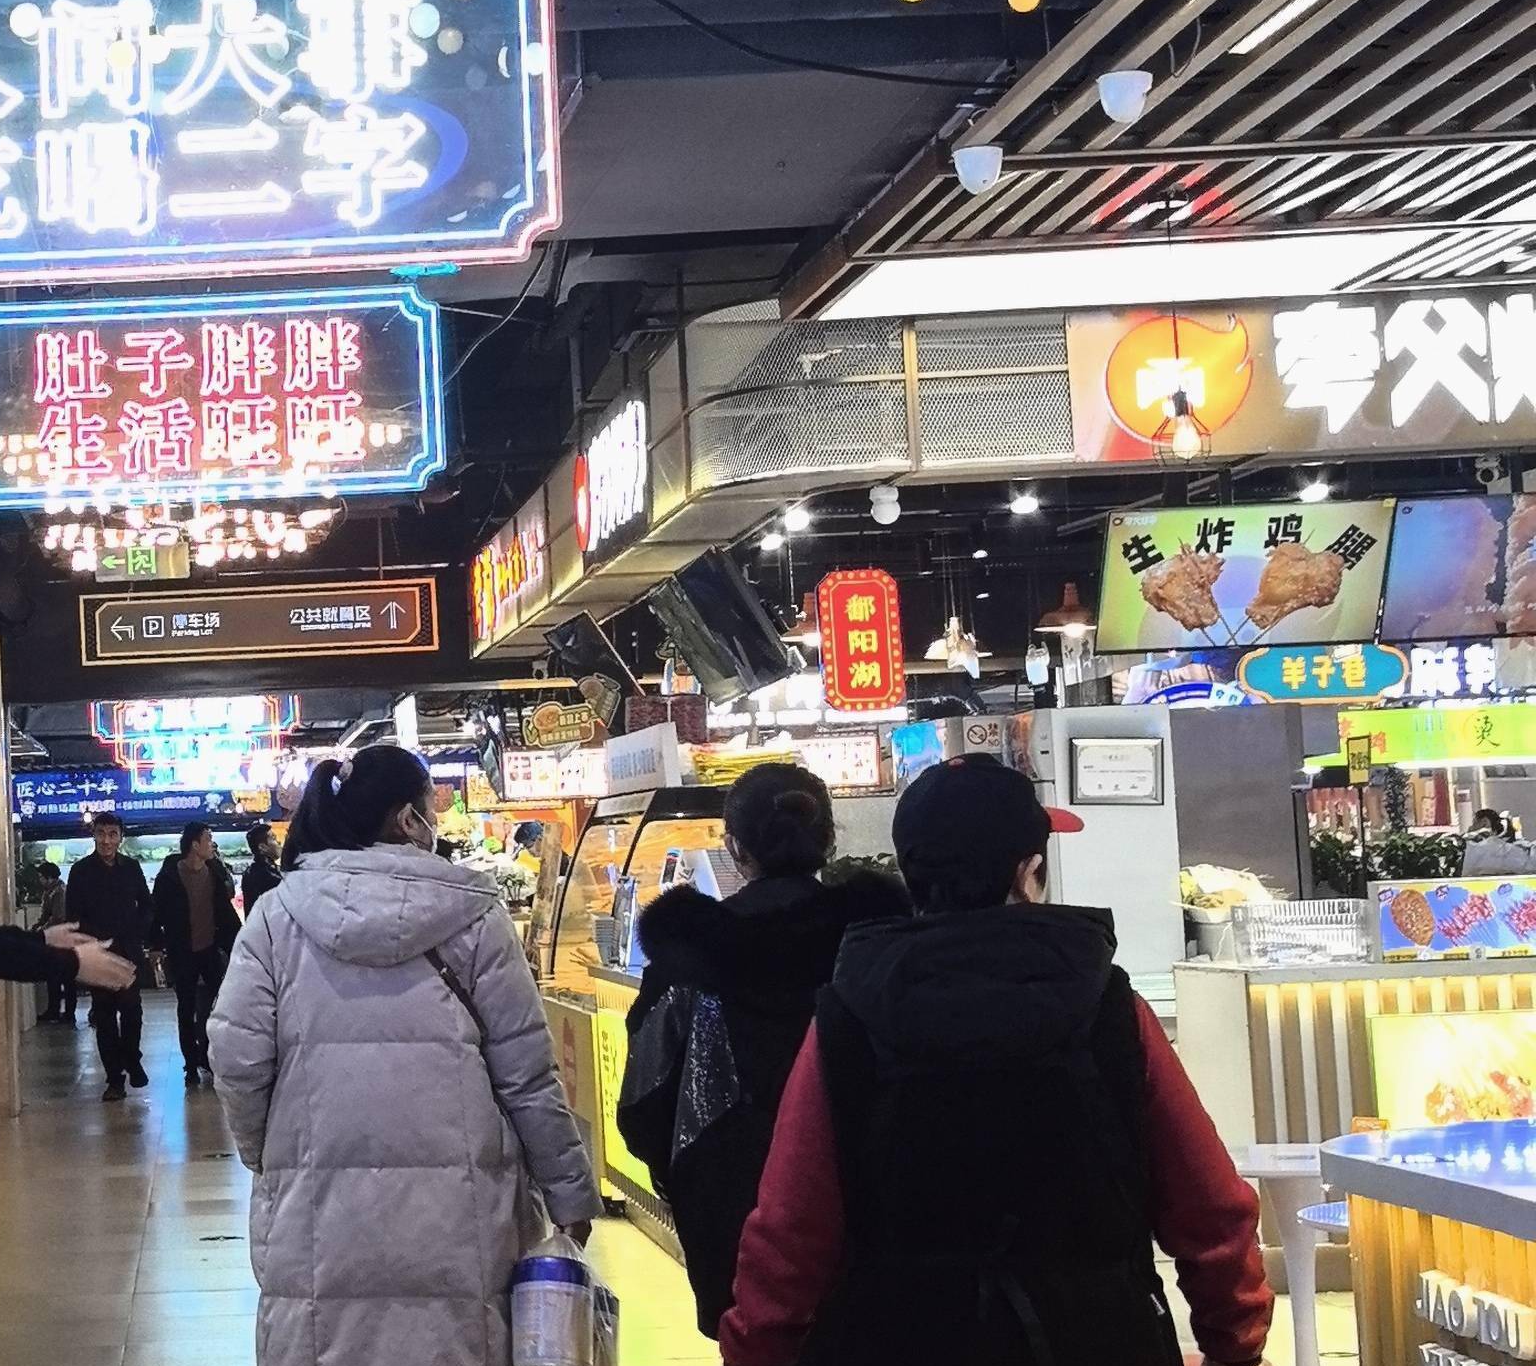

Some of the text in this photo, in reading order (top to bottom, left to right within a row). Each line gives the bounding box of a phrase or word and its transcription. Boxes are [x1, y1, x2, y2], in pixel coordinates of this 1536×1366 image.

[33, 316, 363, 404] 肚子胖胖
[1120, 512, 1379, 576] 生炸鸡腿
[172, 611, 221, 630] 停车场
[843, 593, 883, 690] 鄱阳湖
[1281, 654, 1367, 691] 羊子巷
[15, 777, 120, 799] 匠心二十年
